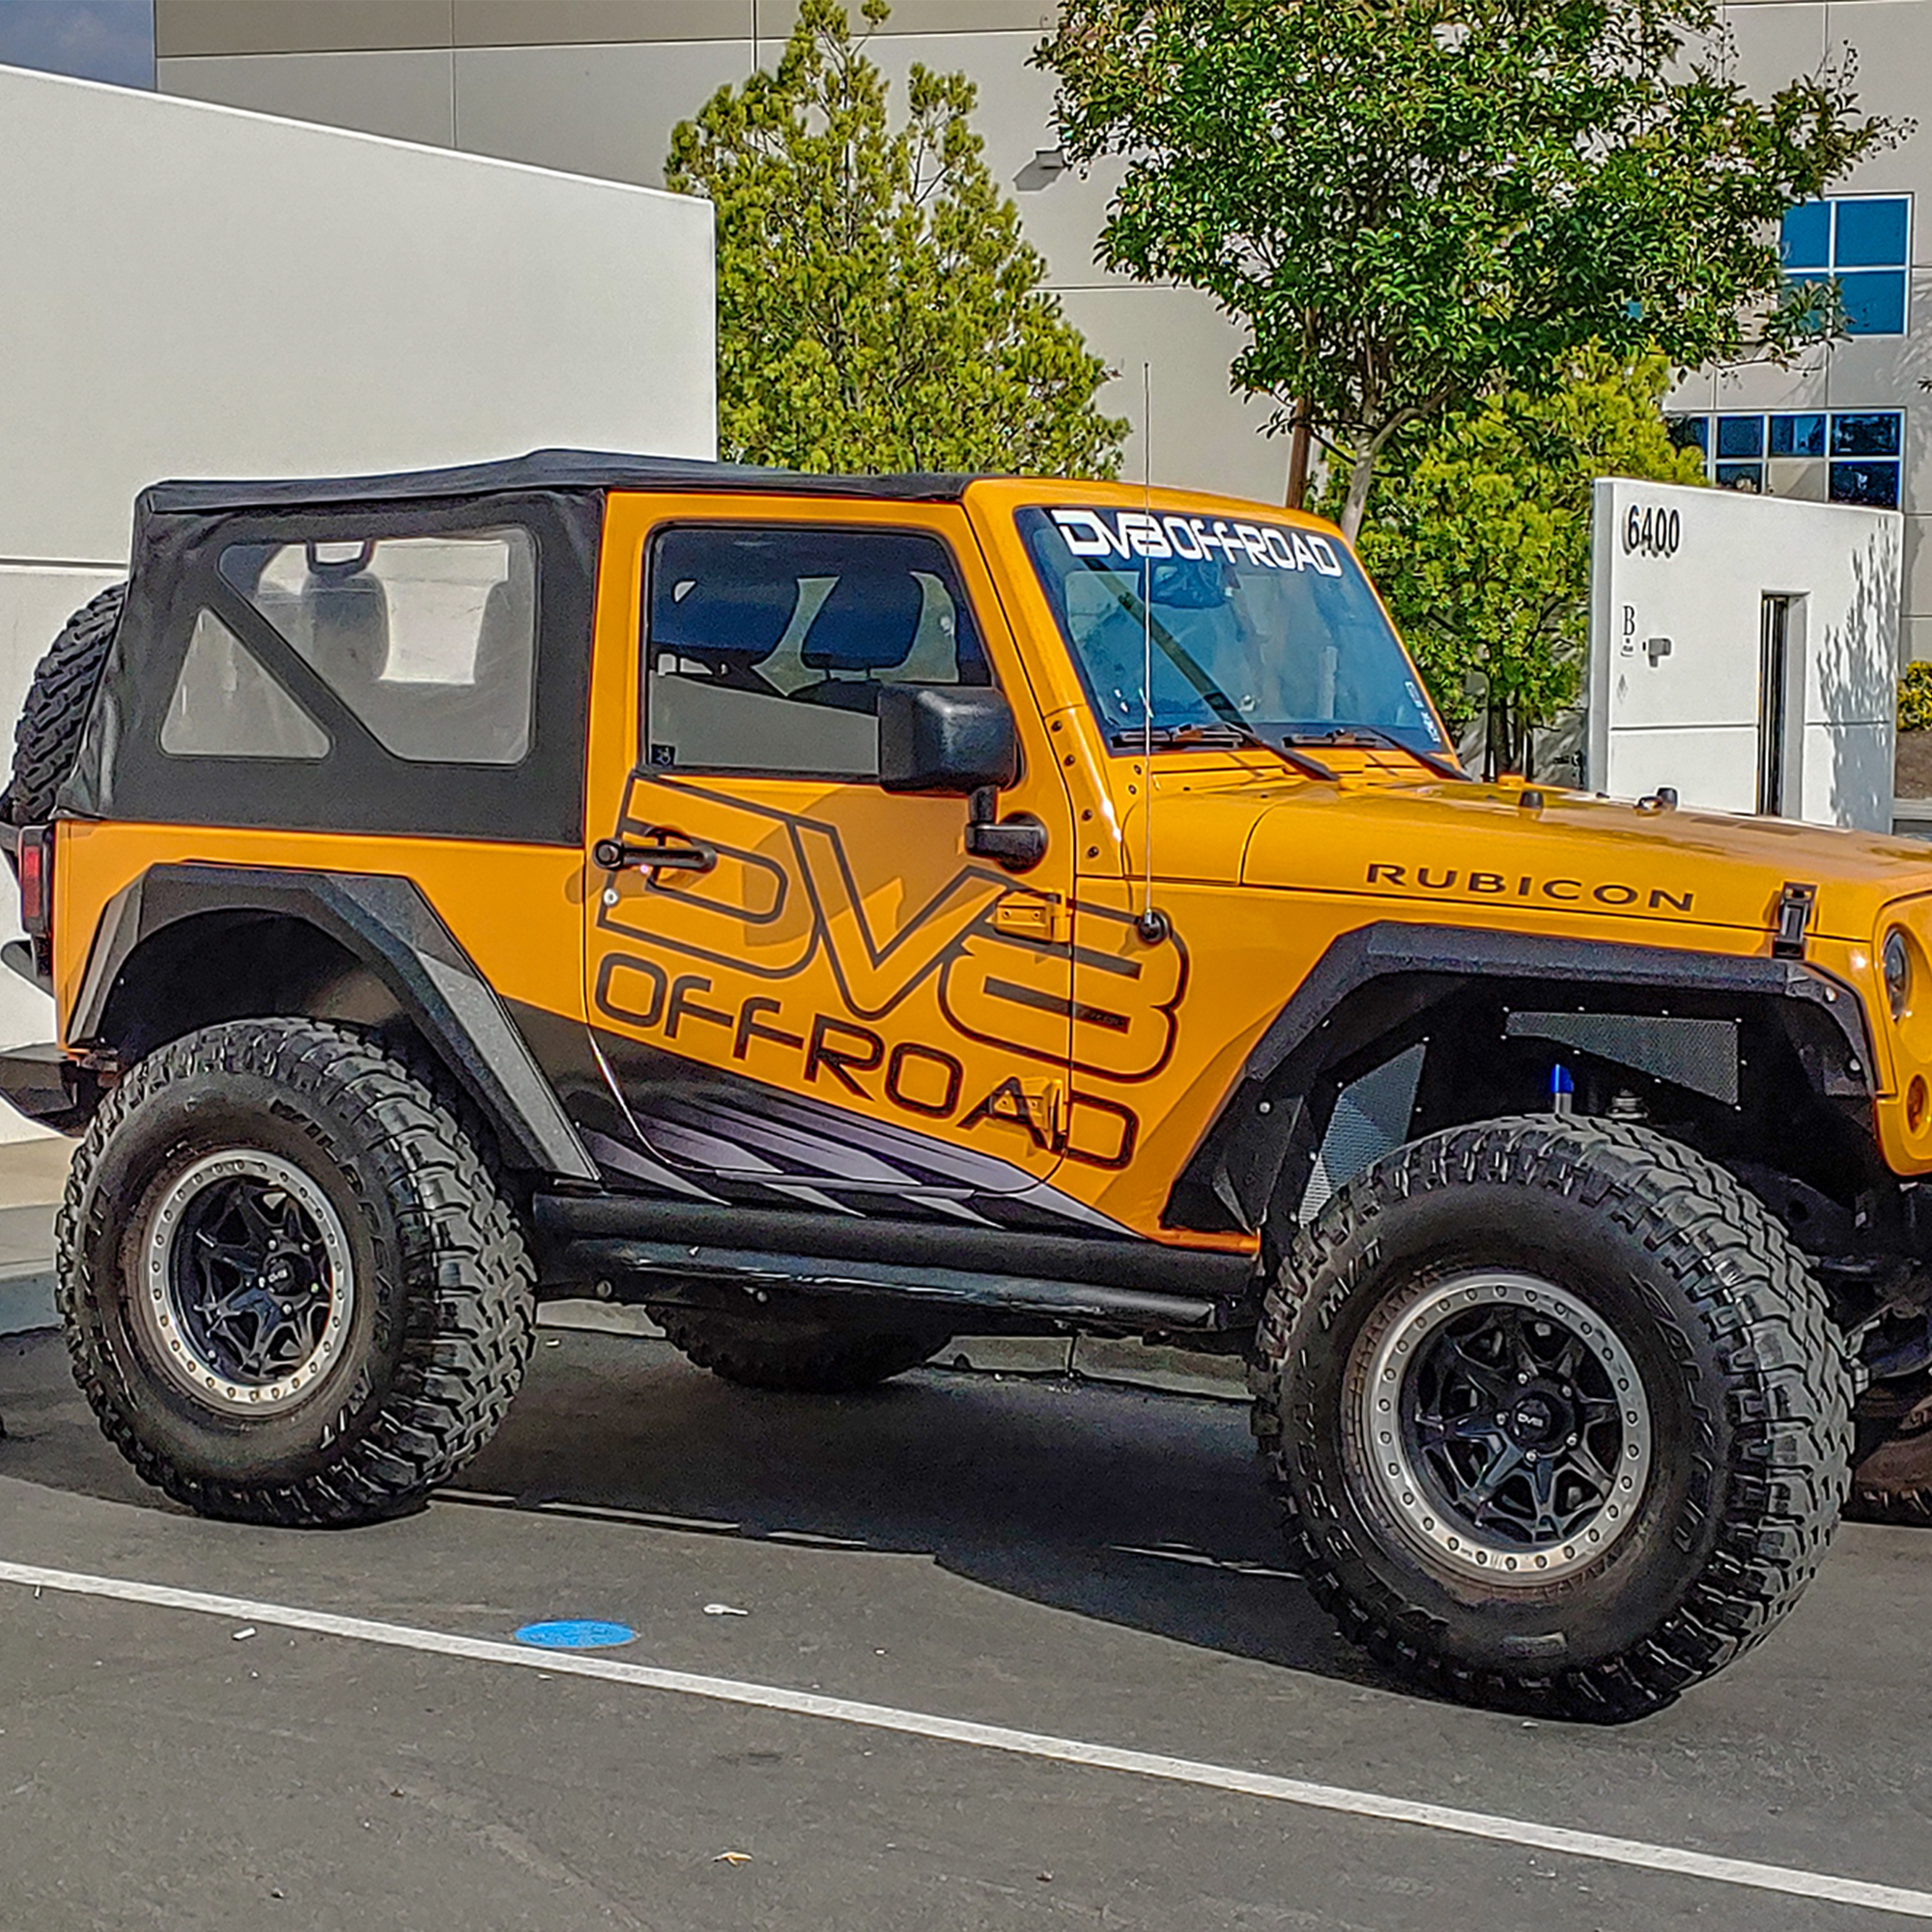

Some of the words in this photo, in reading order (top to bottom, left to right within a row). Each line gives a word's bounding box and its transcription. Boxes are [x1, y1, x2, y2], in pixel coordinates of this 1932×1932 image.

[1628, 505, 1680, 554] 6400
[1623, 605, 1635, 636] B
[1366, 863, 1694, 912] RUBICON
[596, 771, 1189, 1083] DV8
